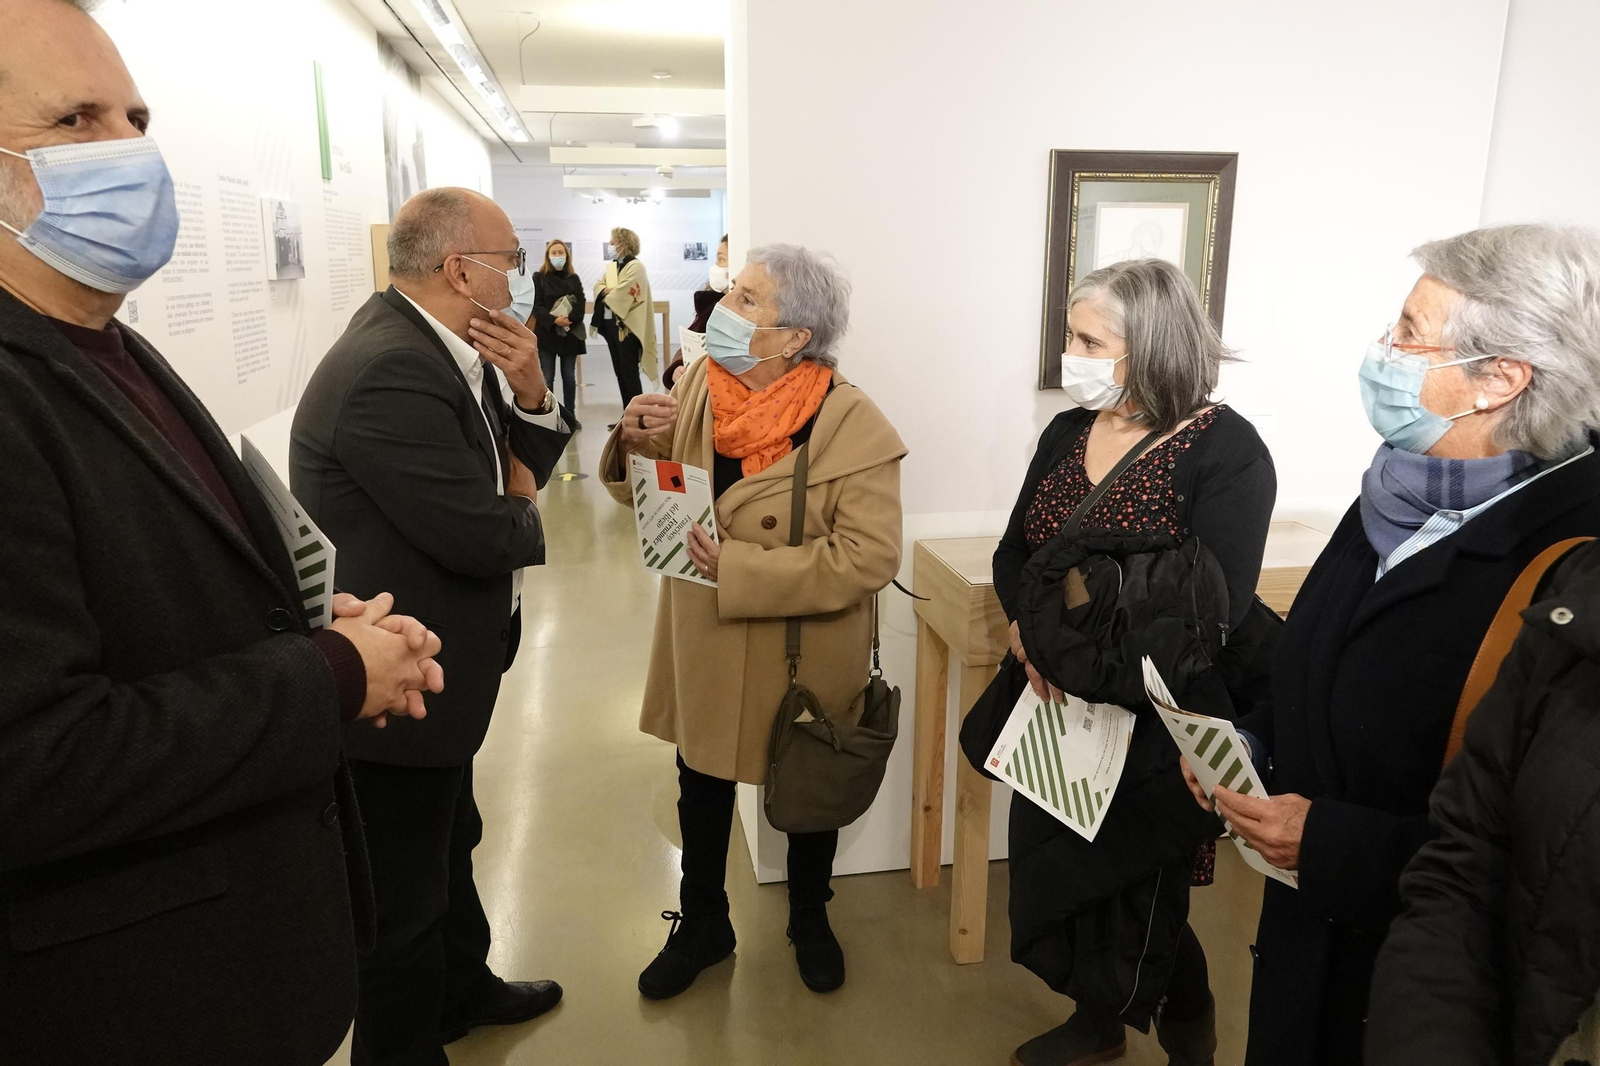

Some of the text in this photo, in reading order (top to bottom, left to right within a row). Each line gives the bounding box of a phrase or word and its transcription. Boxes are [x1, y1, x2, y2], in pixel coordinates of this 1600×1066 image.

[656, 502, 680, 529] del Riego
[666, 514, 692, 542] Francisco
